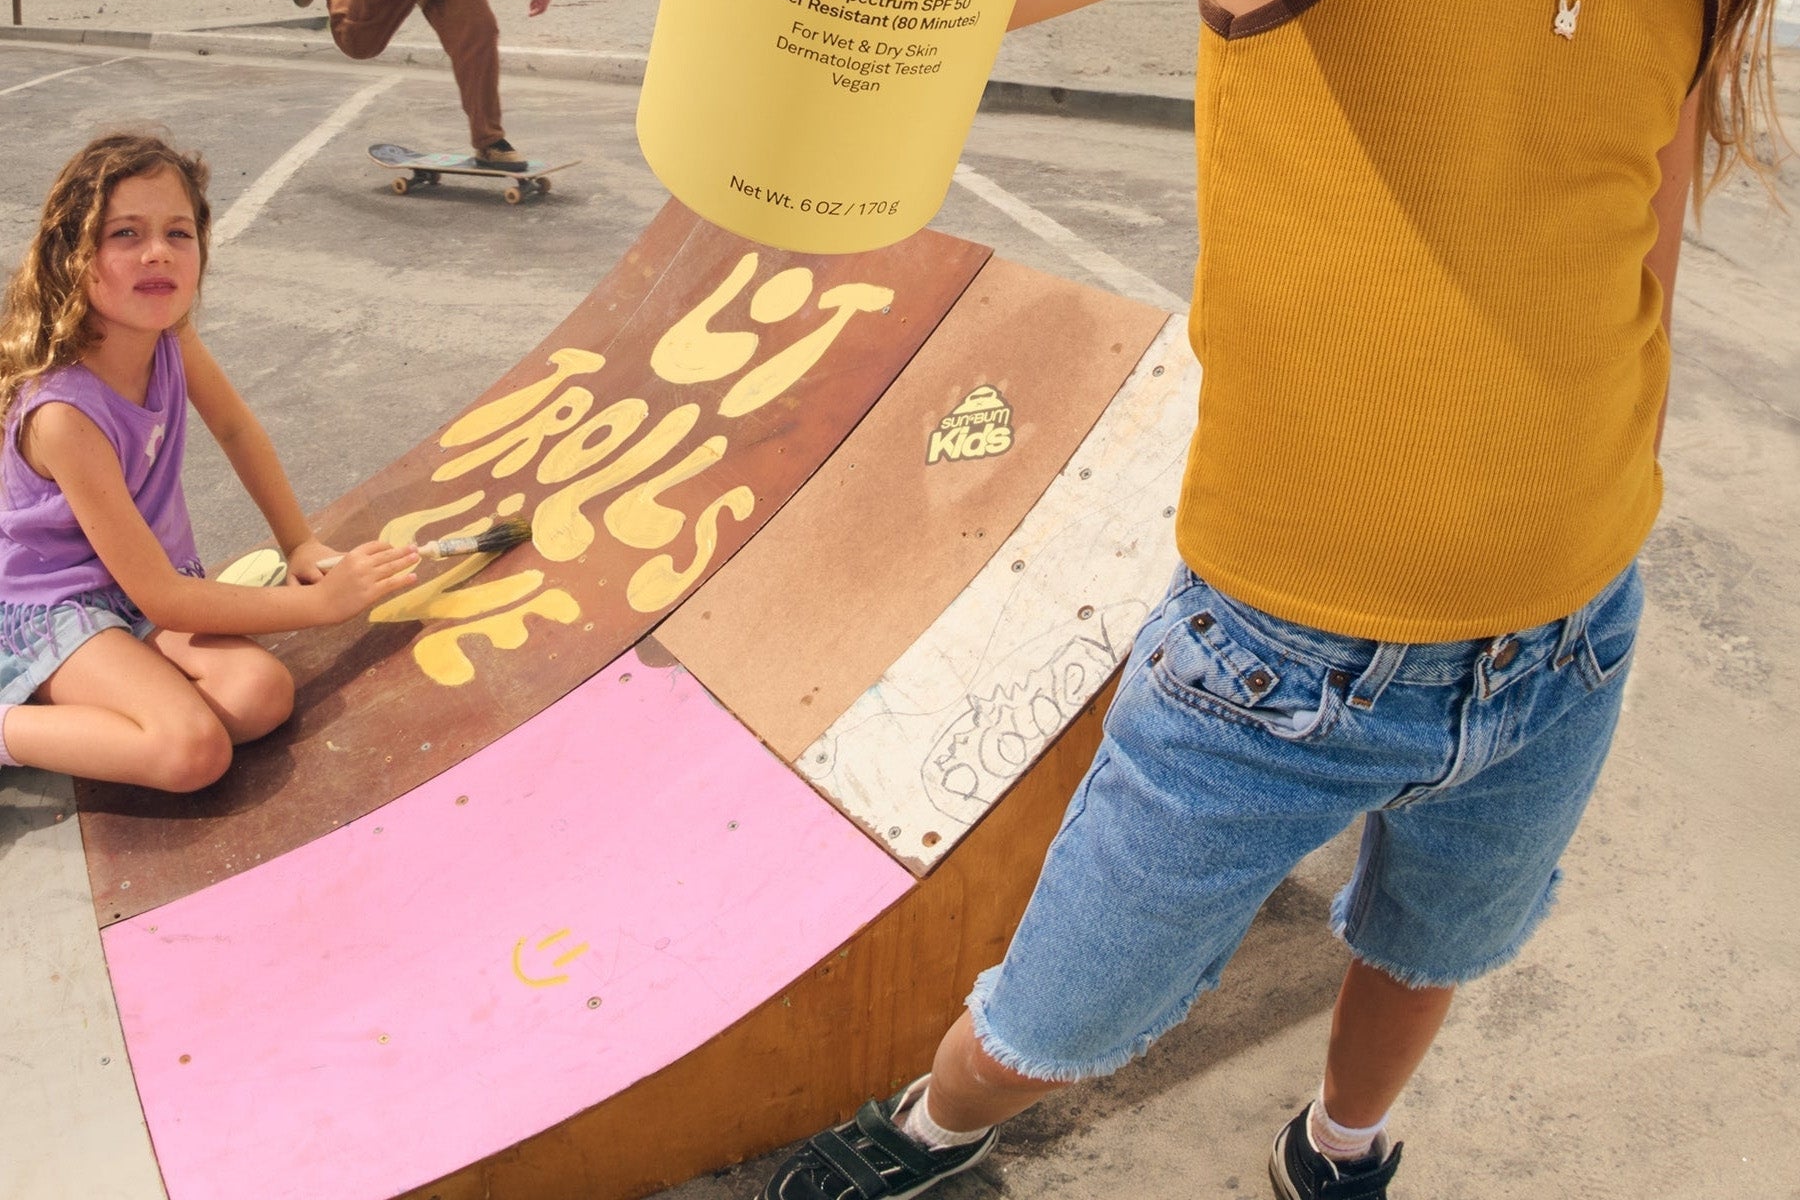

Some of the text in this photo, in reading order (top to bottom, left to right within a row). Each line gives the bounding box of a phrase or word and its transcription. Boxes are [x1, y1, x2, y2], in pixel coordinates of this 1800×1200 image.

[791, 21, 938, 59] For Wet & Dry Skin
[892, 15, 918, 31] (80
[920, 11, 980, 30] Minutes)
[776, 35, 942, 76] Dermatologist Tested
[832, 72, 880, 93] Vegan
[730, 175, 762, 200] Net
[766, 189, 794, 210] Wt.
[800, 199, 812, 212] 6
[815, 201, 842, 216] OZ
[844, 202, 855, 216] /
[650, 252, 895, 418] LOT
[926, 422, 1013, 464] Kids
[430, 347, 756, 613] TROLLS
